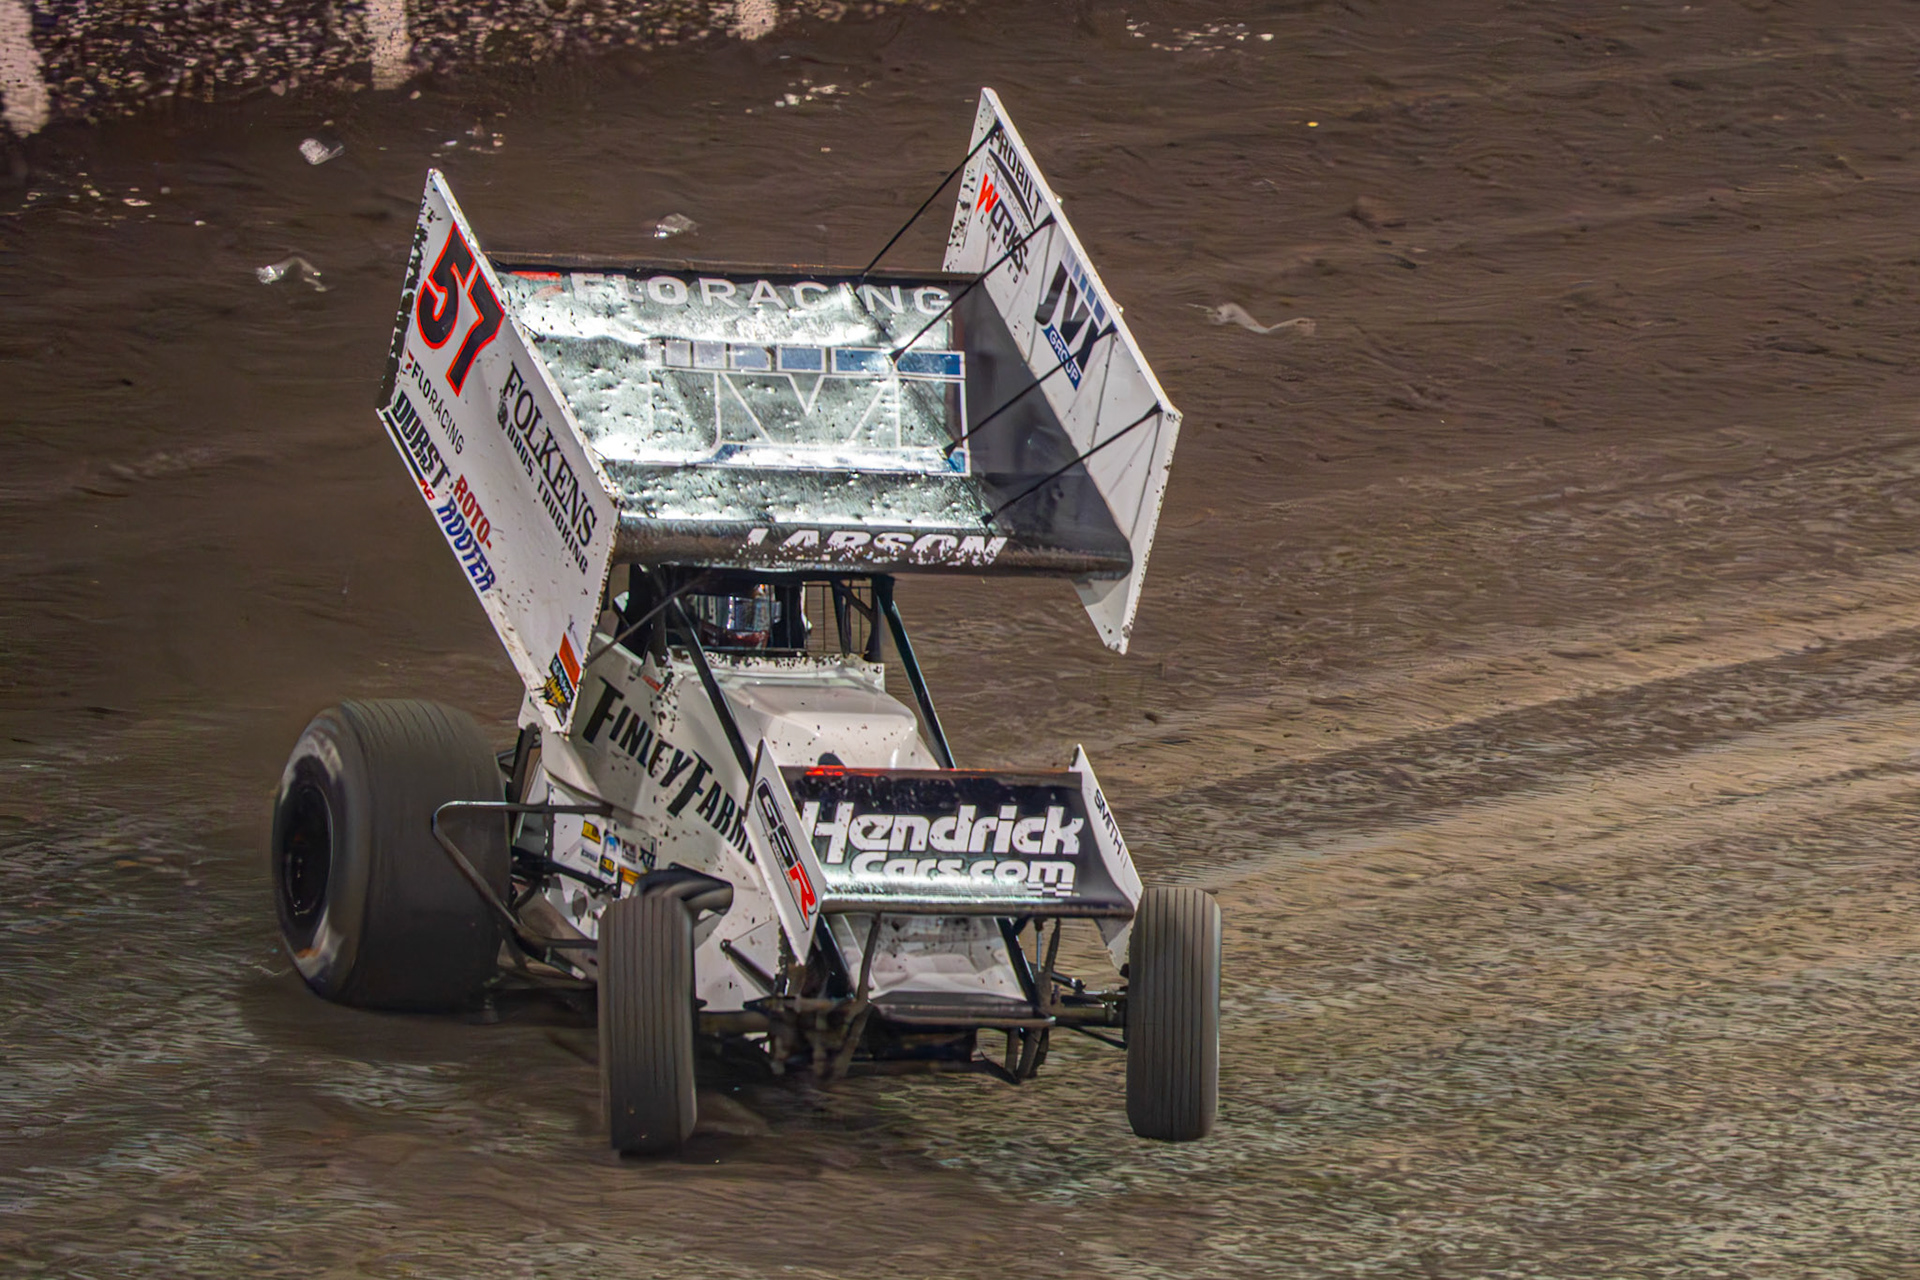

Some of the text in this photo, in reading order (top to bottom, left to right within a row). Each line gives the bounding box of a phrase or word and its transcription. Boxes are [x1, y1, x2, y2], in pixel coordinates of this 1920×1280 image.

[988, 126, 1042, 221] PROBILT
[416, 221, 505, 397] 57
[570, 272, 951, 315] FLORACING
[392, 389, 451, 489] DURST
[411, 361, 465, 455] FLORACING
[503, 362, 598, 547] FOLKENS
[436, 495, 497, 593] ROOTER
[453, 473, 492, 551] ROTO-
[536, 475, 589, 576] TRUCKING
[582, 676, 693, 788] FINLEY
[757, 781, 818, 923] GSR
[801, 801, 1084, 864] Hendrick
